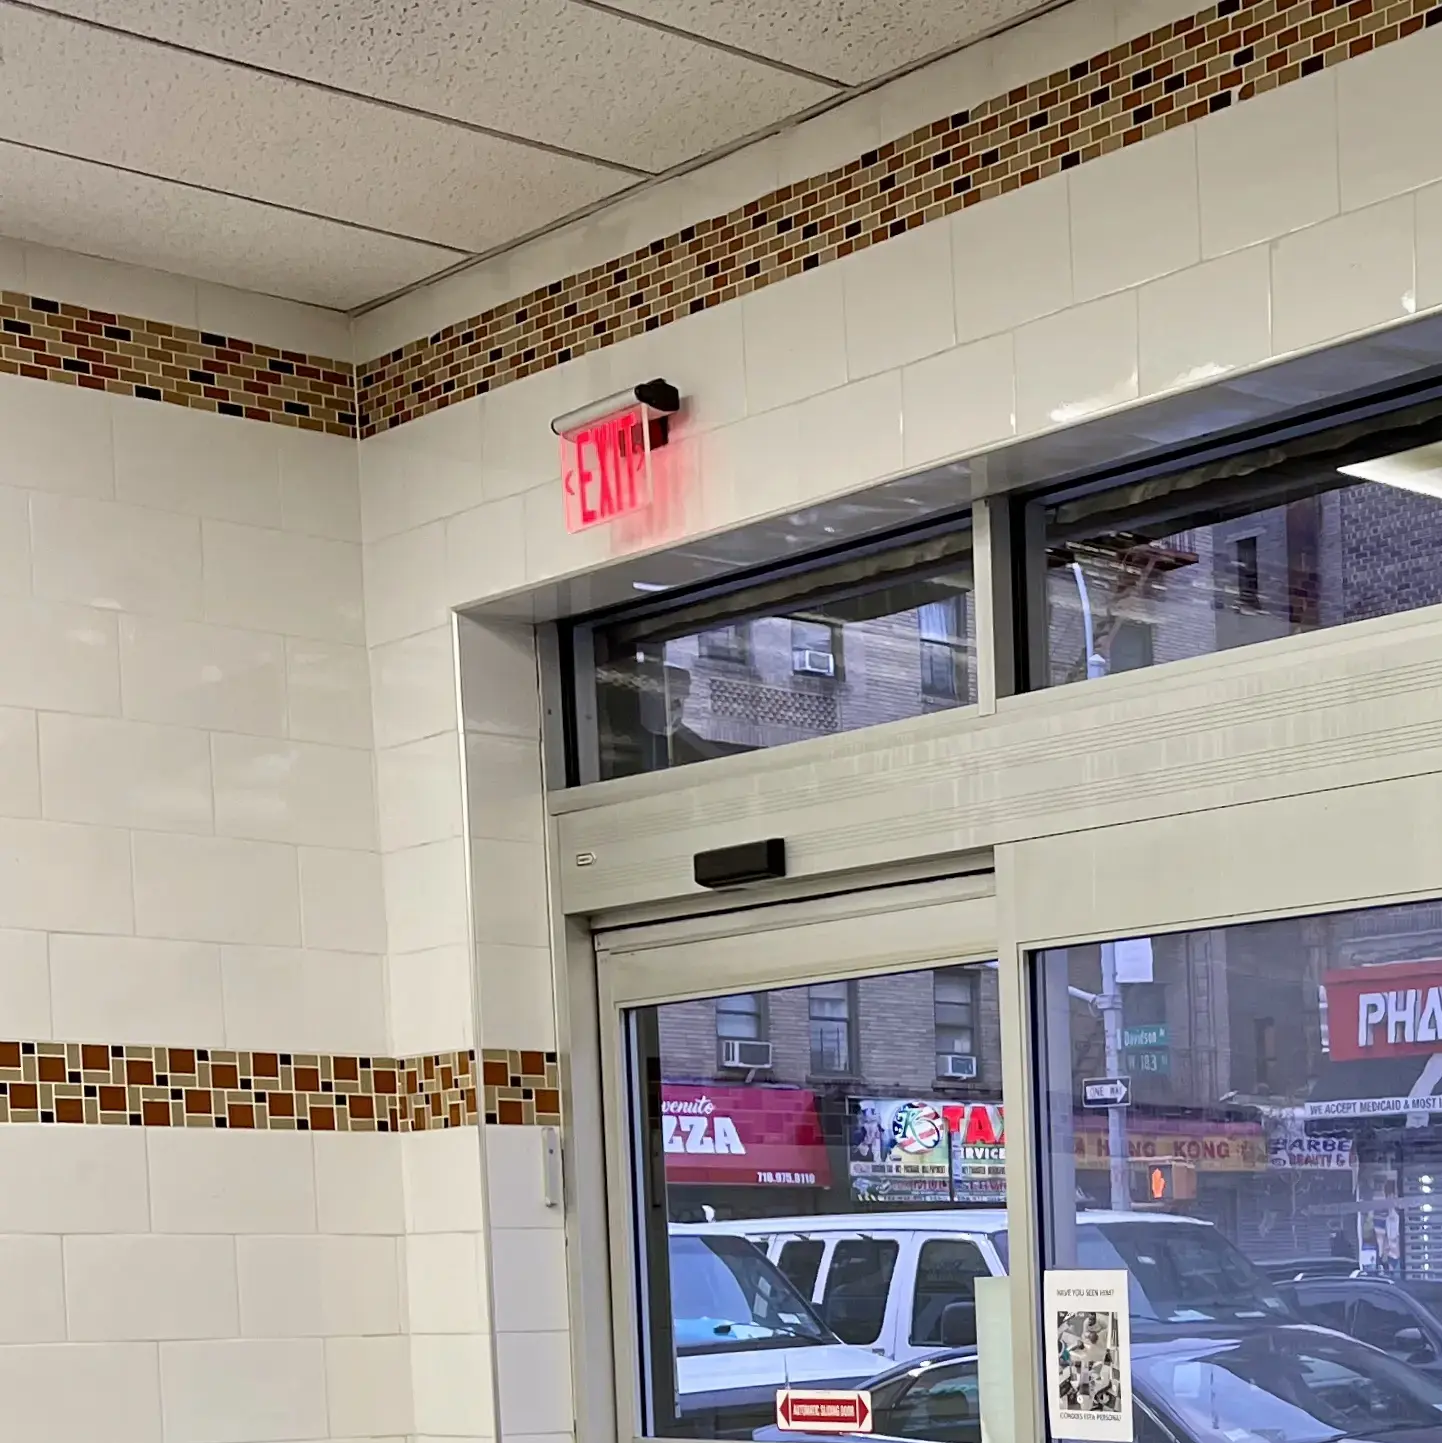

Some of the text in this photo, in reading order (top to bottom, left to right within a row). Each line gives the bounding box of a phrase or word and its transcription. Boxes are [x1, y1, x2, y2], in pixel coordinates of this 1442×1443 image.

[577, 412, 635, 524] EXIT
[1124, 1029, 1157, 1047] Davidson
[1140, 1054, 1157, 1071] 183
[1089, 1086, 1104, 1097] ONE
[1310, 1105, 1323, 1116] WE
[1324, 1101, 1357, 1114] ACCEPT
[1360, 1100, 1401, 1113] MEDICAID
[1403, 1099, 1411, 1109] &
[1412, 1097, 1436, 1109] MOST
[1097, 1138, 1156, 1157] HNG
[1173, 1138, 1230, 1159] KONG
[1072, 1289, 1085, 1297] YOU
[1086, 1289, 1099, 1297] SEEN
[793, 1404, 855, 1417] AUTOMATIC SLIDING DOOR
